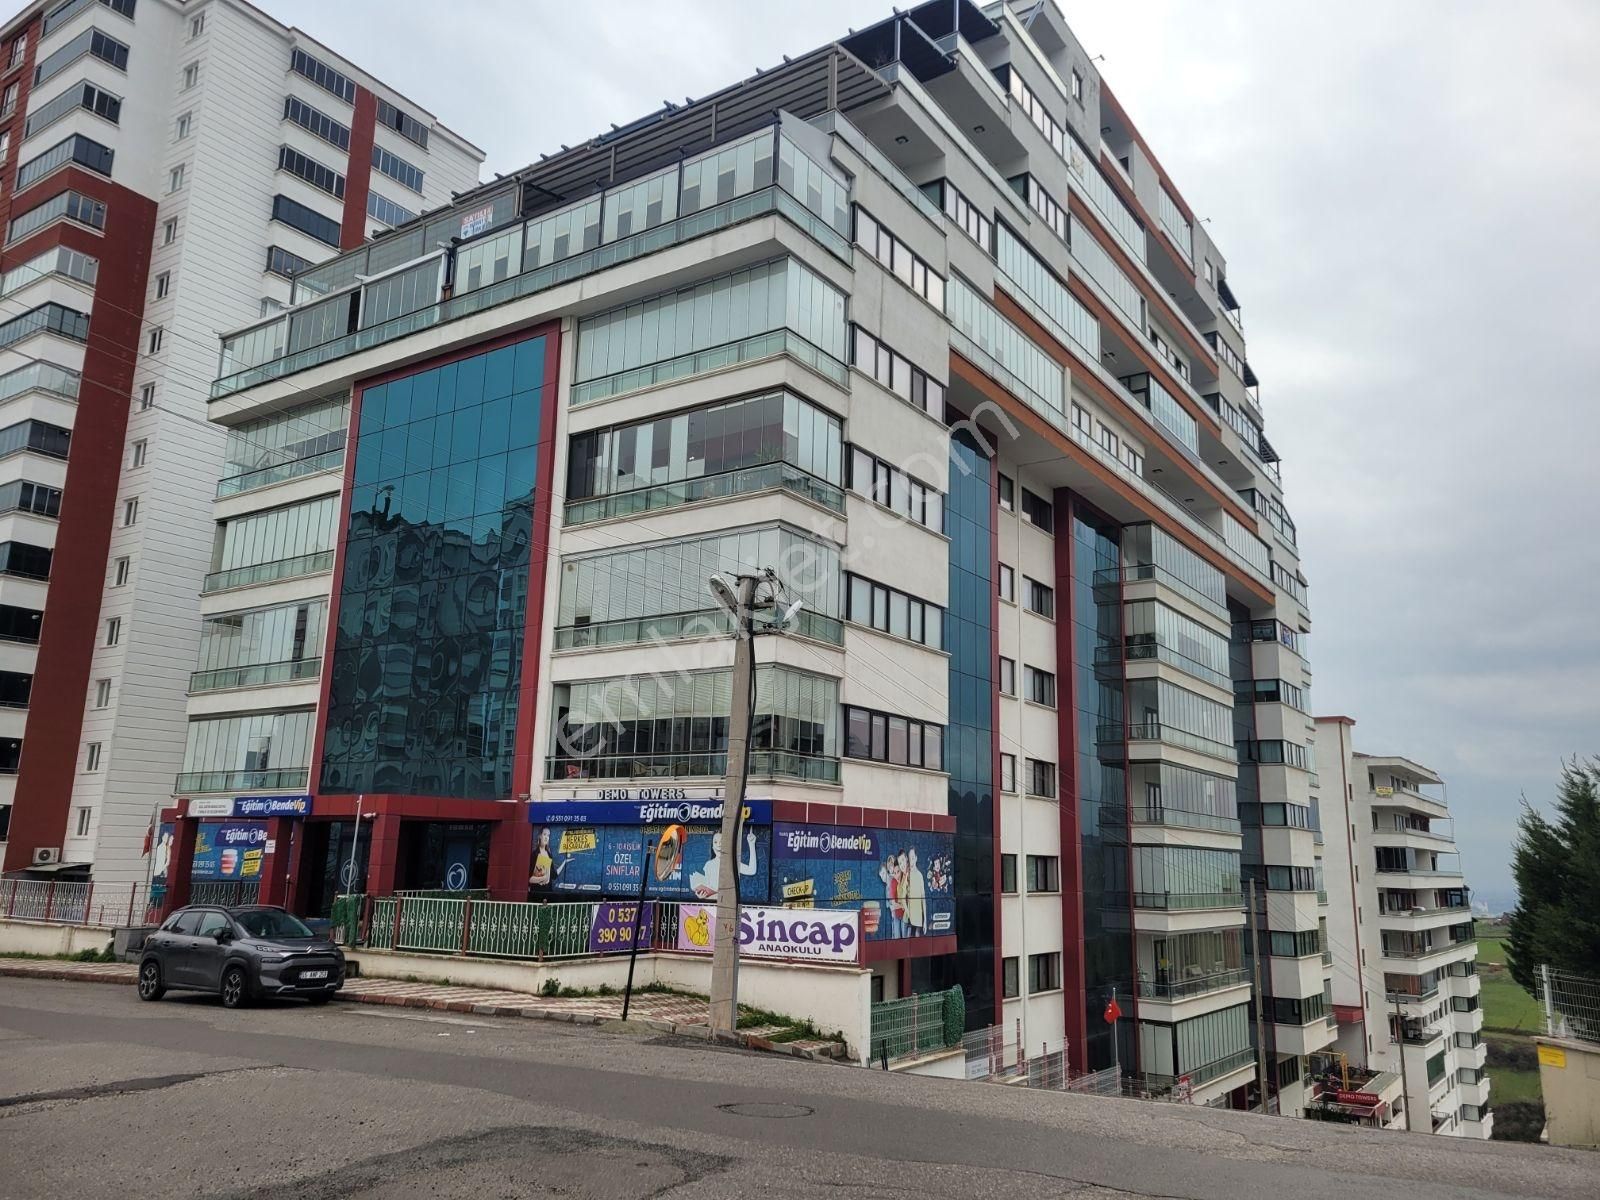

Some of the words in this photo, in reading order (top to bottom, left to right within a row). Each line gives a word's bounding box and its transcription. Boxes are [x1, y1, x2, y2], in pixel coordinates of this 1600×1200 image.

[597, 788, 629, 800] DEMO
[638, 787, 687, 800] TOWERS
[241, 798, 264, 814] Eğitim
[640, 803, 678, 822] Eğitim
[225, 828, 248, 844] Eğitim
[787, 830, 819, 852] Eğitim
[614, 851, 633, 864] ÖZEL
[606, 865, 640, 876] SINIFLAR
[609, 910, 615, 923] 0
[618, 907, 637, 923] 537
[598, 928, 617, 943] 390
[619, 926, 632, 943] 90
[738, 910, 856, 953] Sincap
[758, 943, 822, 955] ANAOKULU
